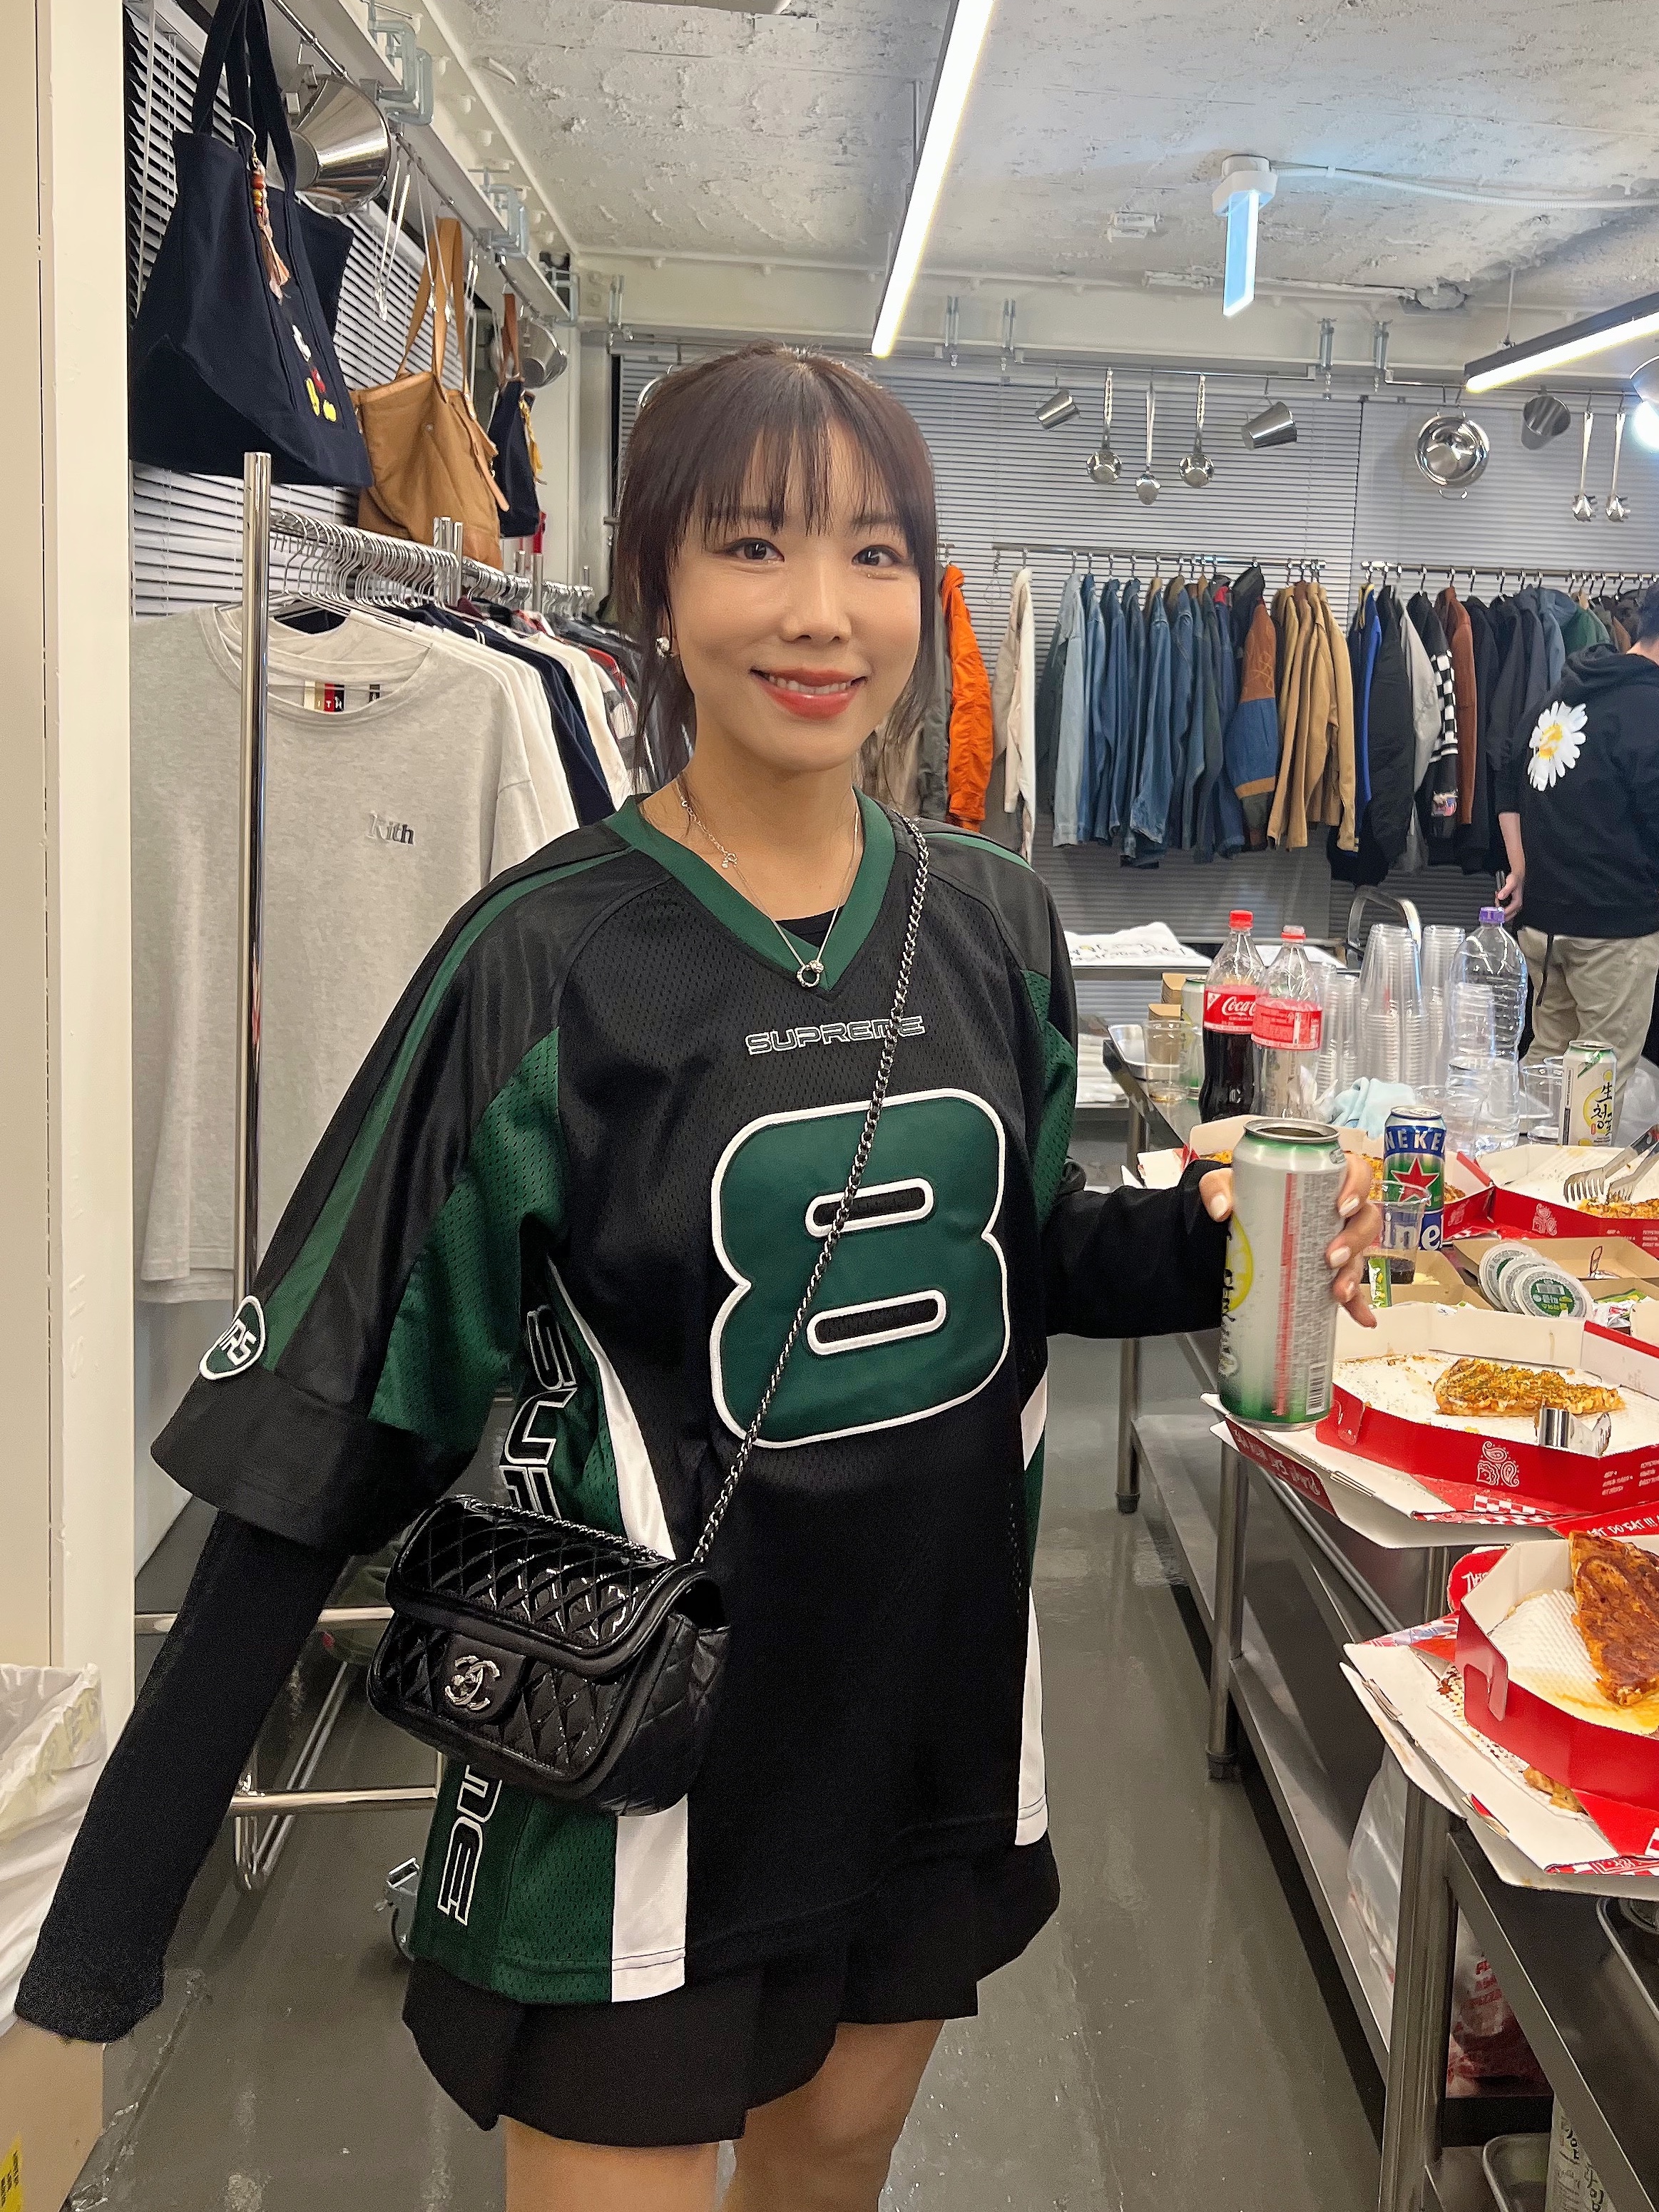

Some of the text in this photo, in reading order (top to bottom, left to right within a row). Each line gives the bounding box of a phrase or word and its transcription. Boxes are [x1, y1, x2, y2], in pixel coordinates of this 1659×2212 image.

[366, 810, 415, 846] Kith
[745, 1015, 926, 1055] SUPREME
[710, 1087, 1011, 1435] 8
